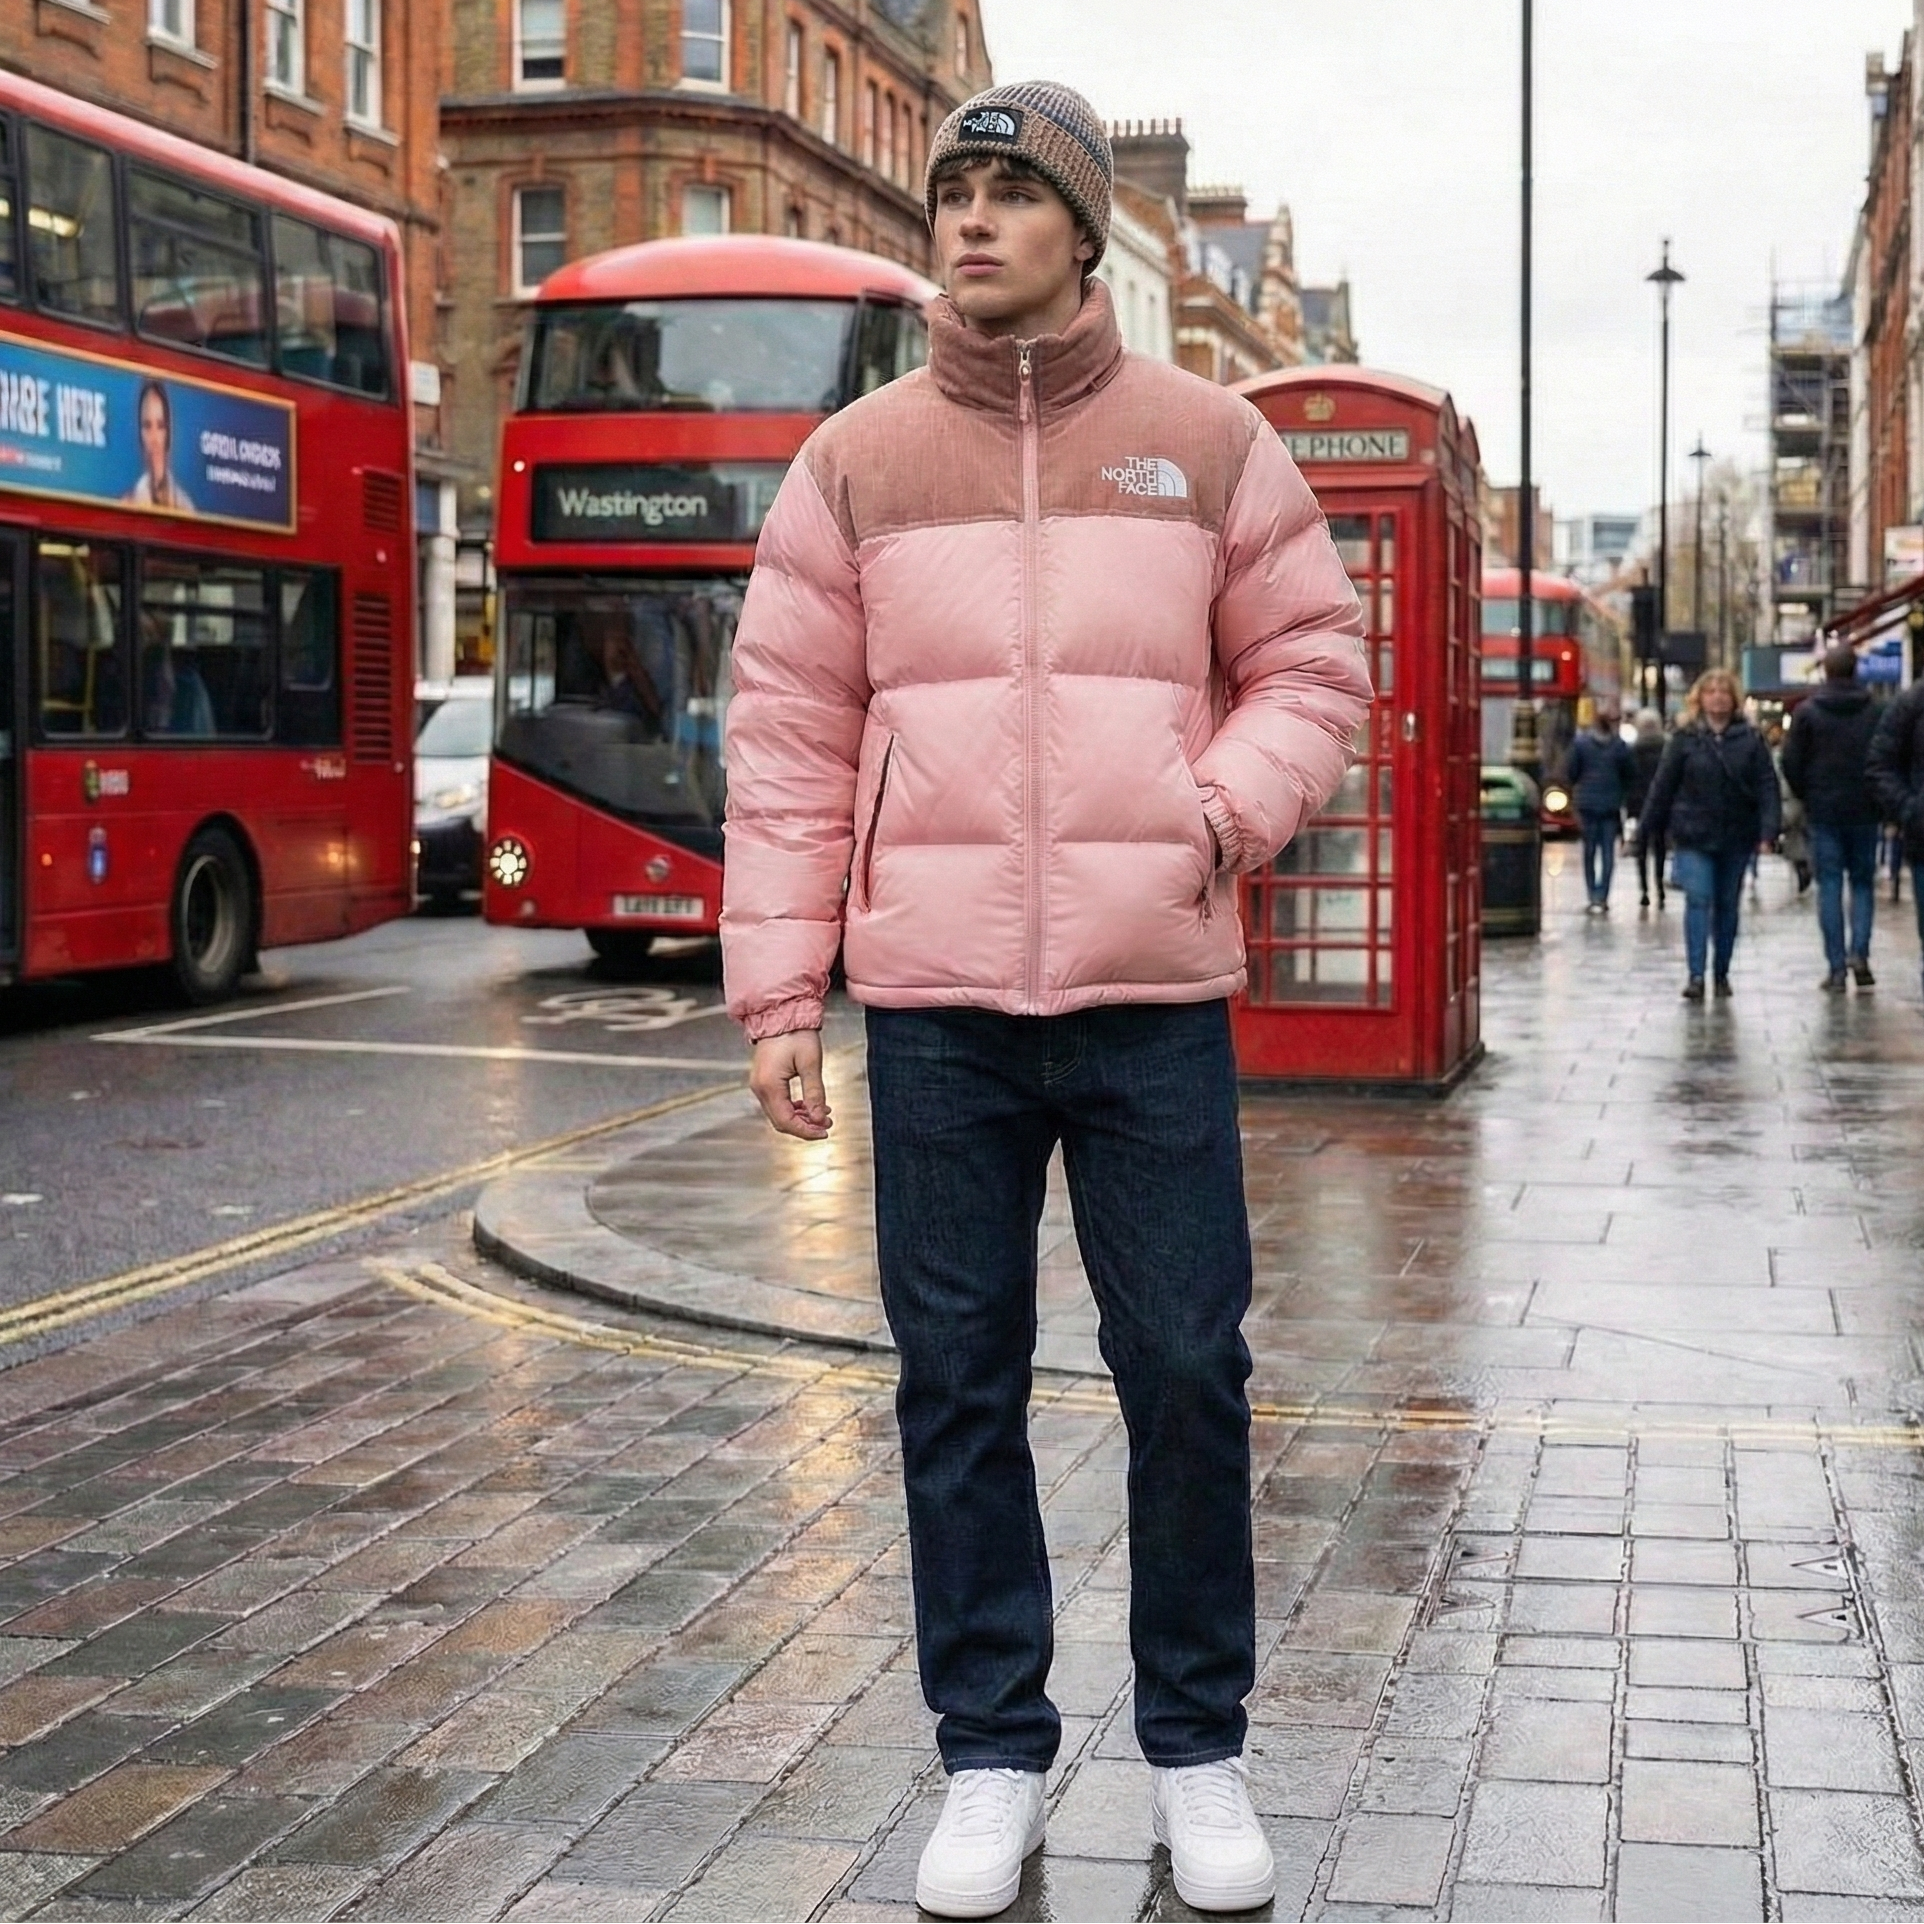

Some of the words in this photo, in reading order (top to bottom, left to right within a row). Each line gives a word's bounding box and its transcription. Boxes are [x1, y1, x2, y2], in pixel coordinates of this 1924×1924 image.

[1124, 456, 1158, 471] THE
[1101, 466, 1157, 486] NORTH
[1118, 481, 1158, 496] FACE
[557, 487, 708, 526] Wastington
